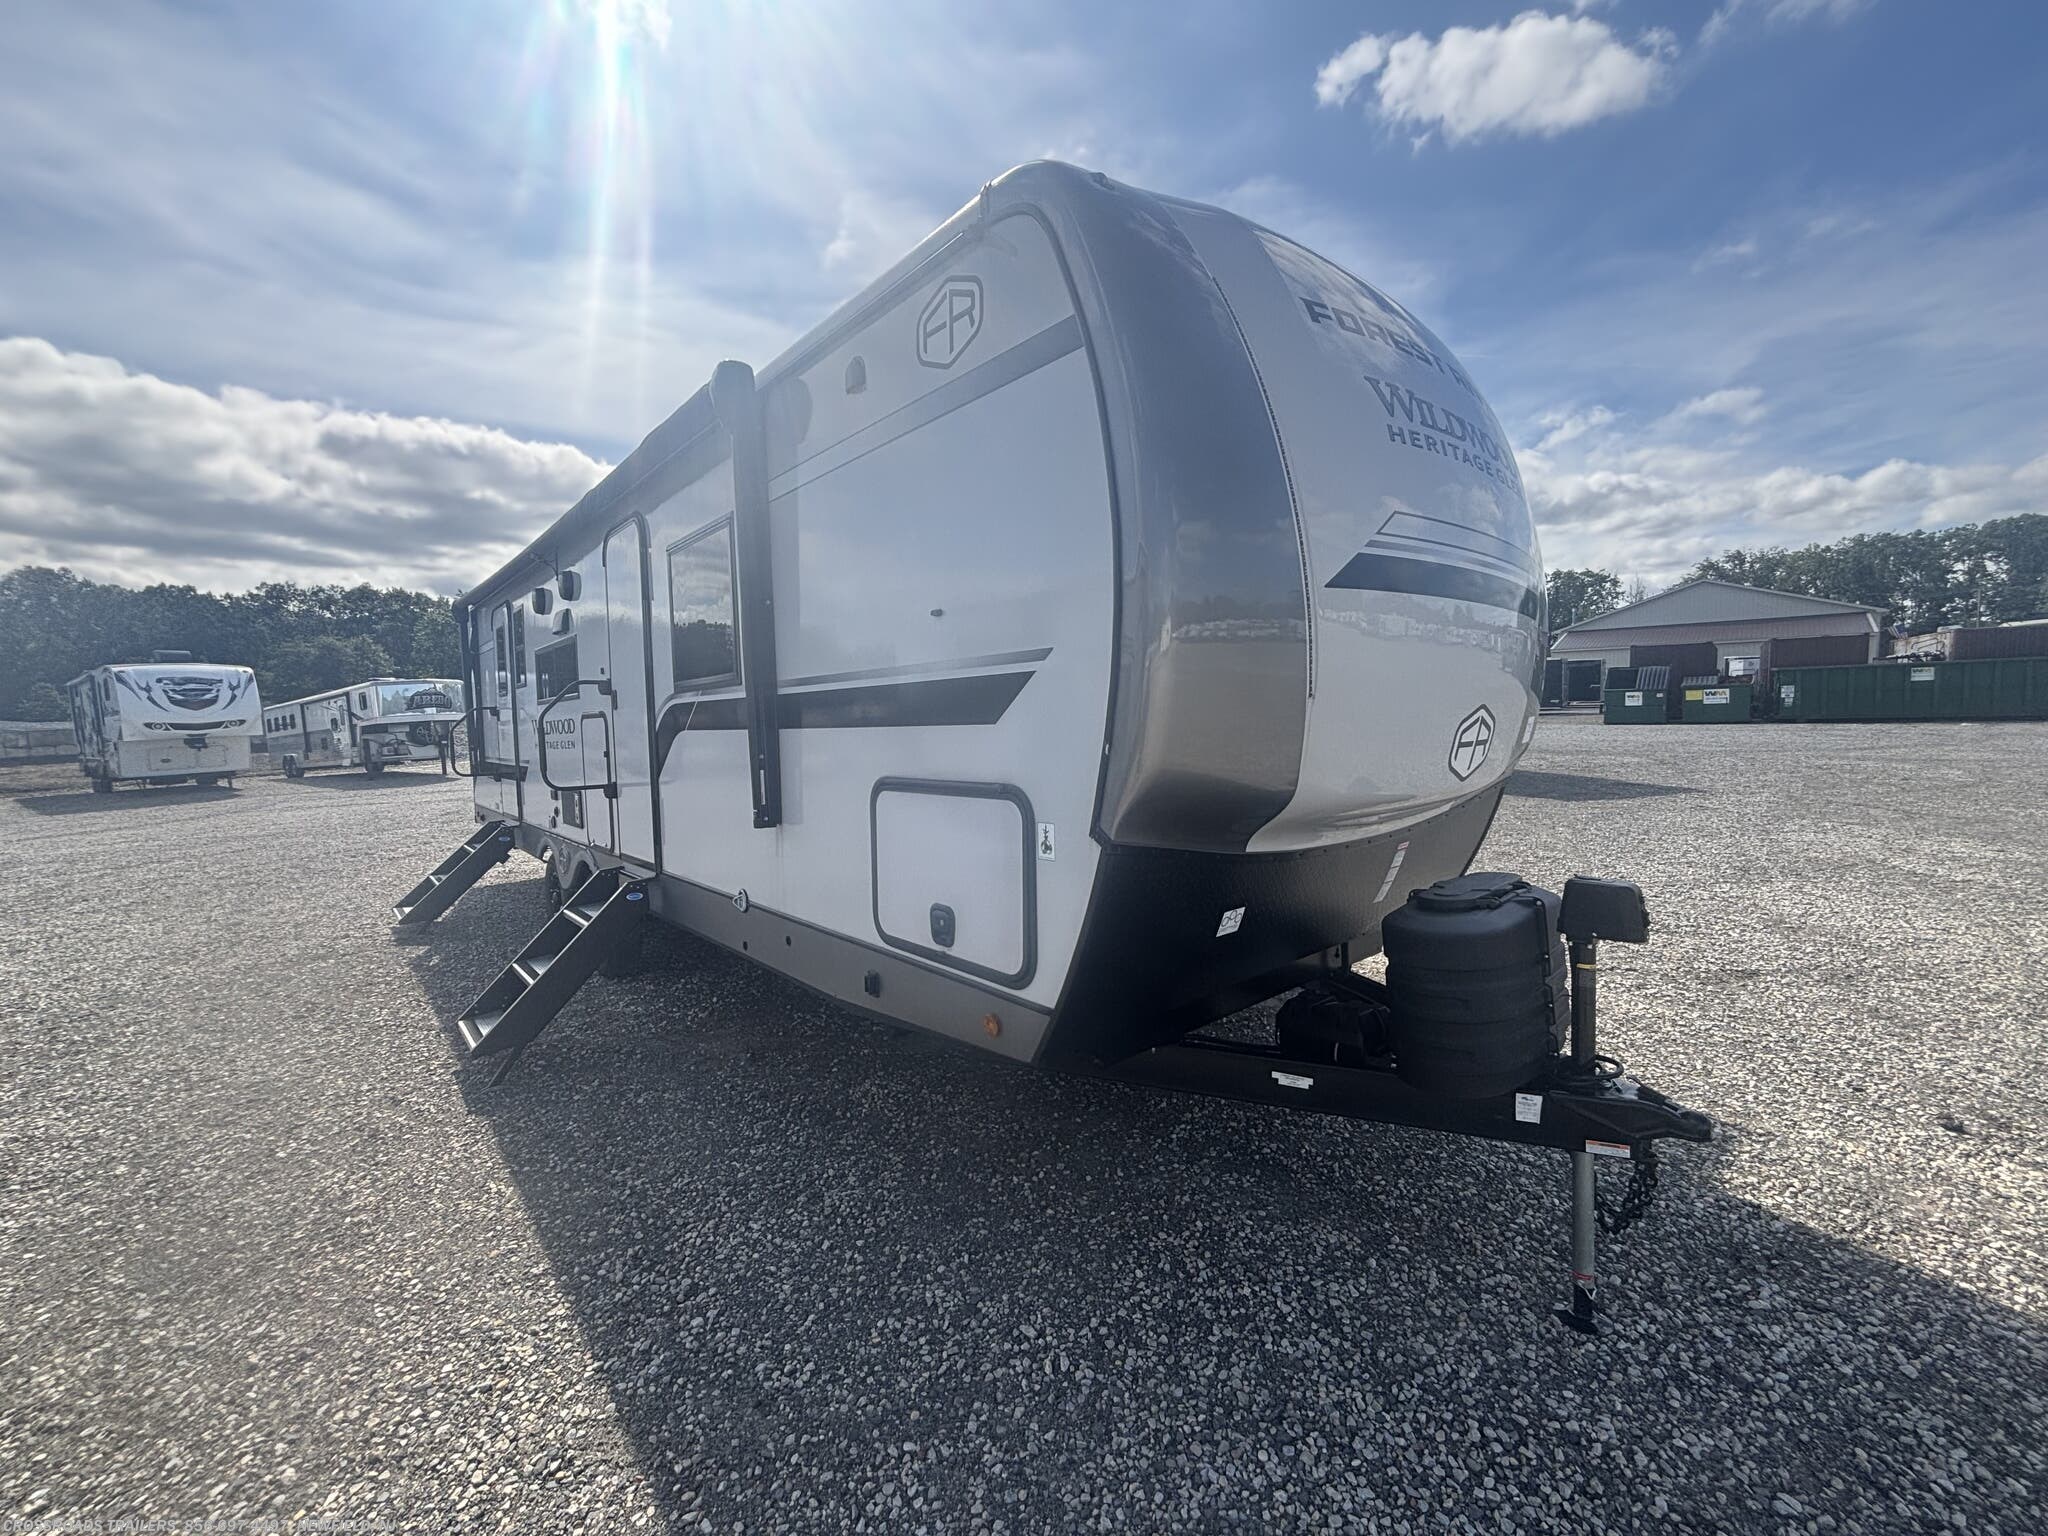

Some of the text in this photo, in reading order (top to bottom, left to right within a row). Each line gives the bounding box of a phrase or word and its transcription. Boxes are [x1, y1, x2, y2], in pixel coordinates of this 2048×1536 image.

[1299, 296, 1445, 375] FOREST
[1386, 423, 1494, 477] HERITAGE
[531, 718, 576, 735] WDWOOD
